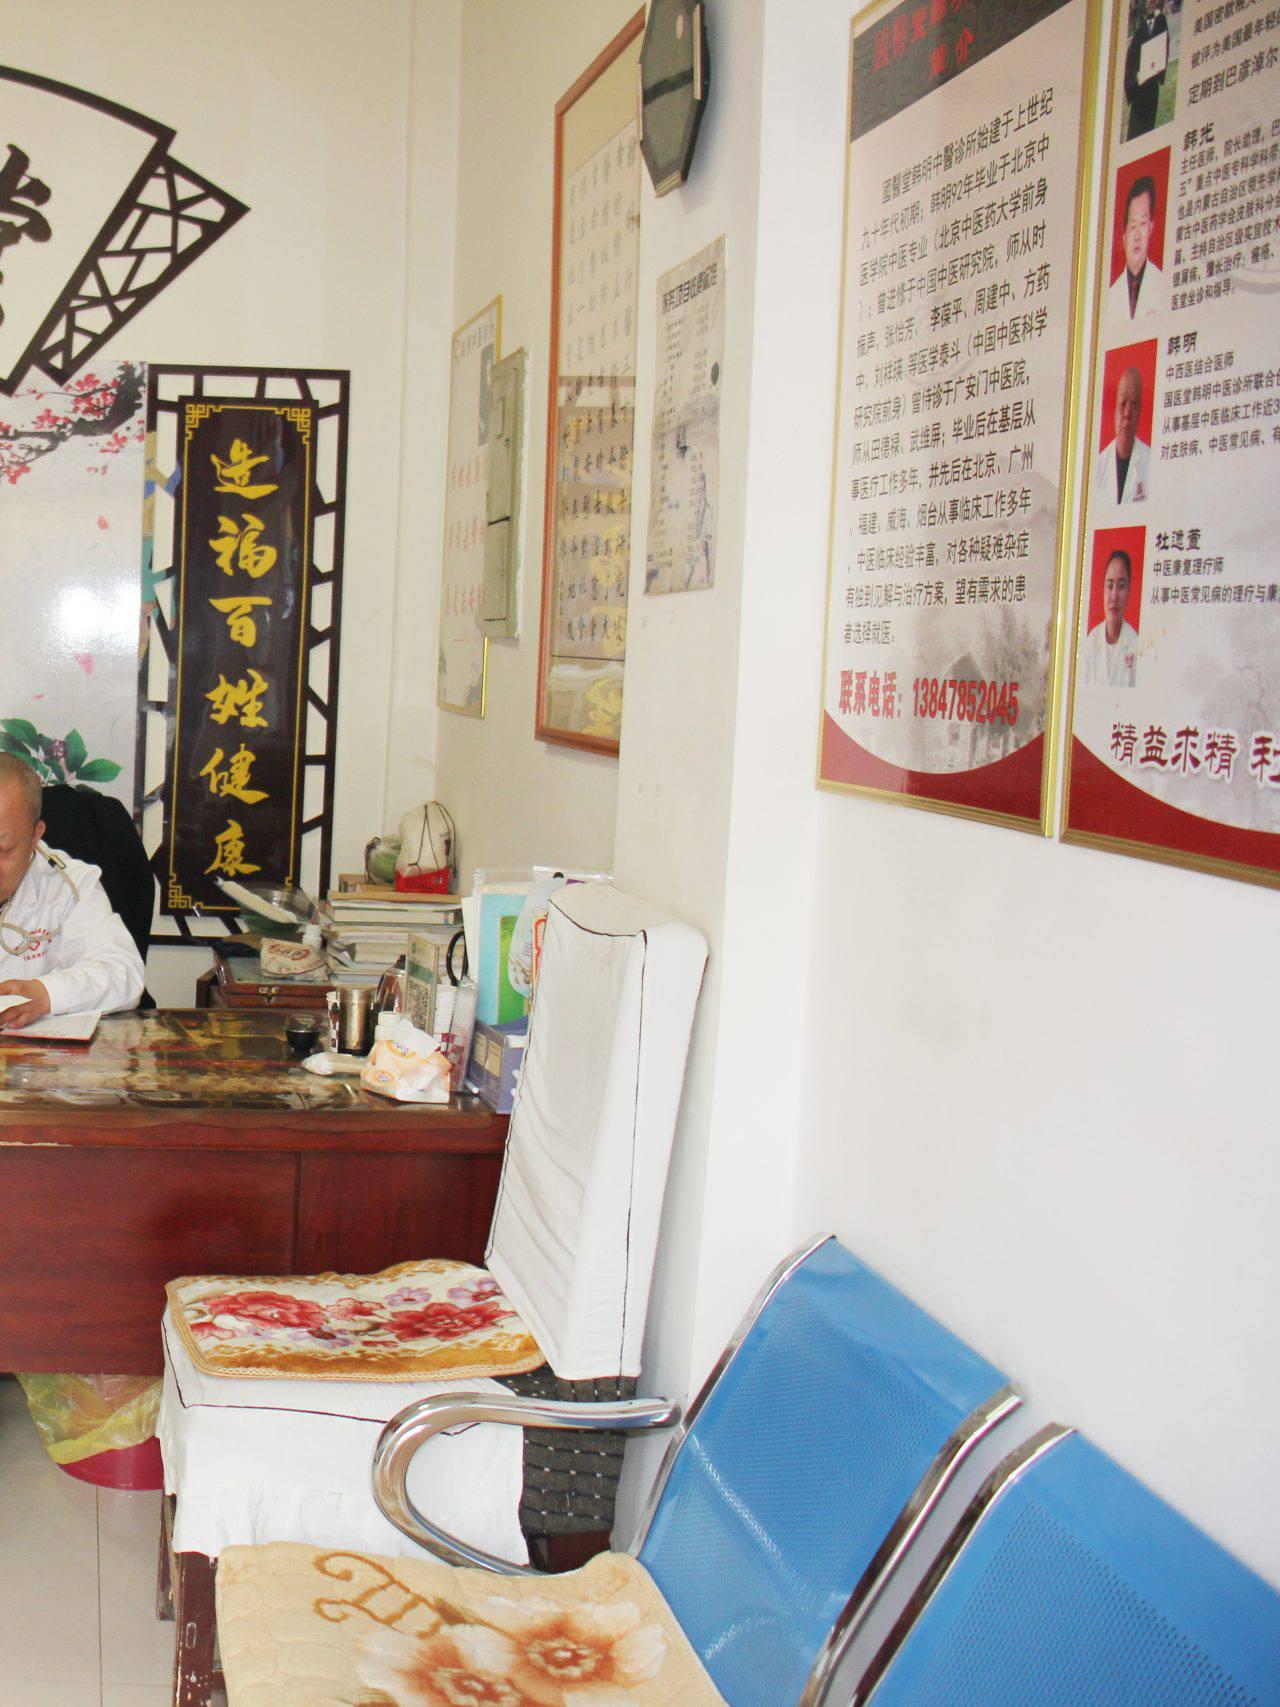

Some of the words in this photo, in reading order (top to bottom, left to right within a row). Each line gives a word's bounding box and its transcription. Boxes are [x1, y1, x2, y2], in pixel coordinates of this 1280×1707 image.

[1167, 332, 1198, 357] 韩明
[1166, 351, 1234, 383] 中西医结合医师
[1153, 556, 1224, 578] 中医康复理疗师
[198, 438, 279, 878] 造福百姓健康
[1110, 721, 1237, 778] 精益求精
